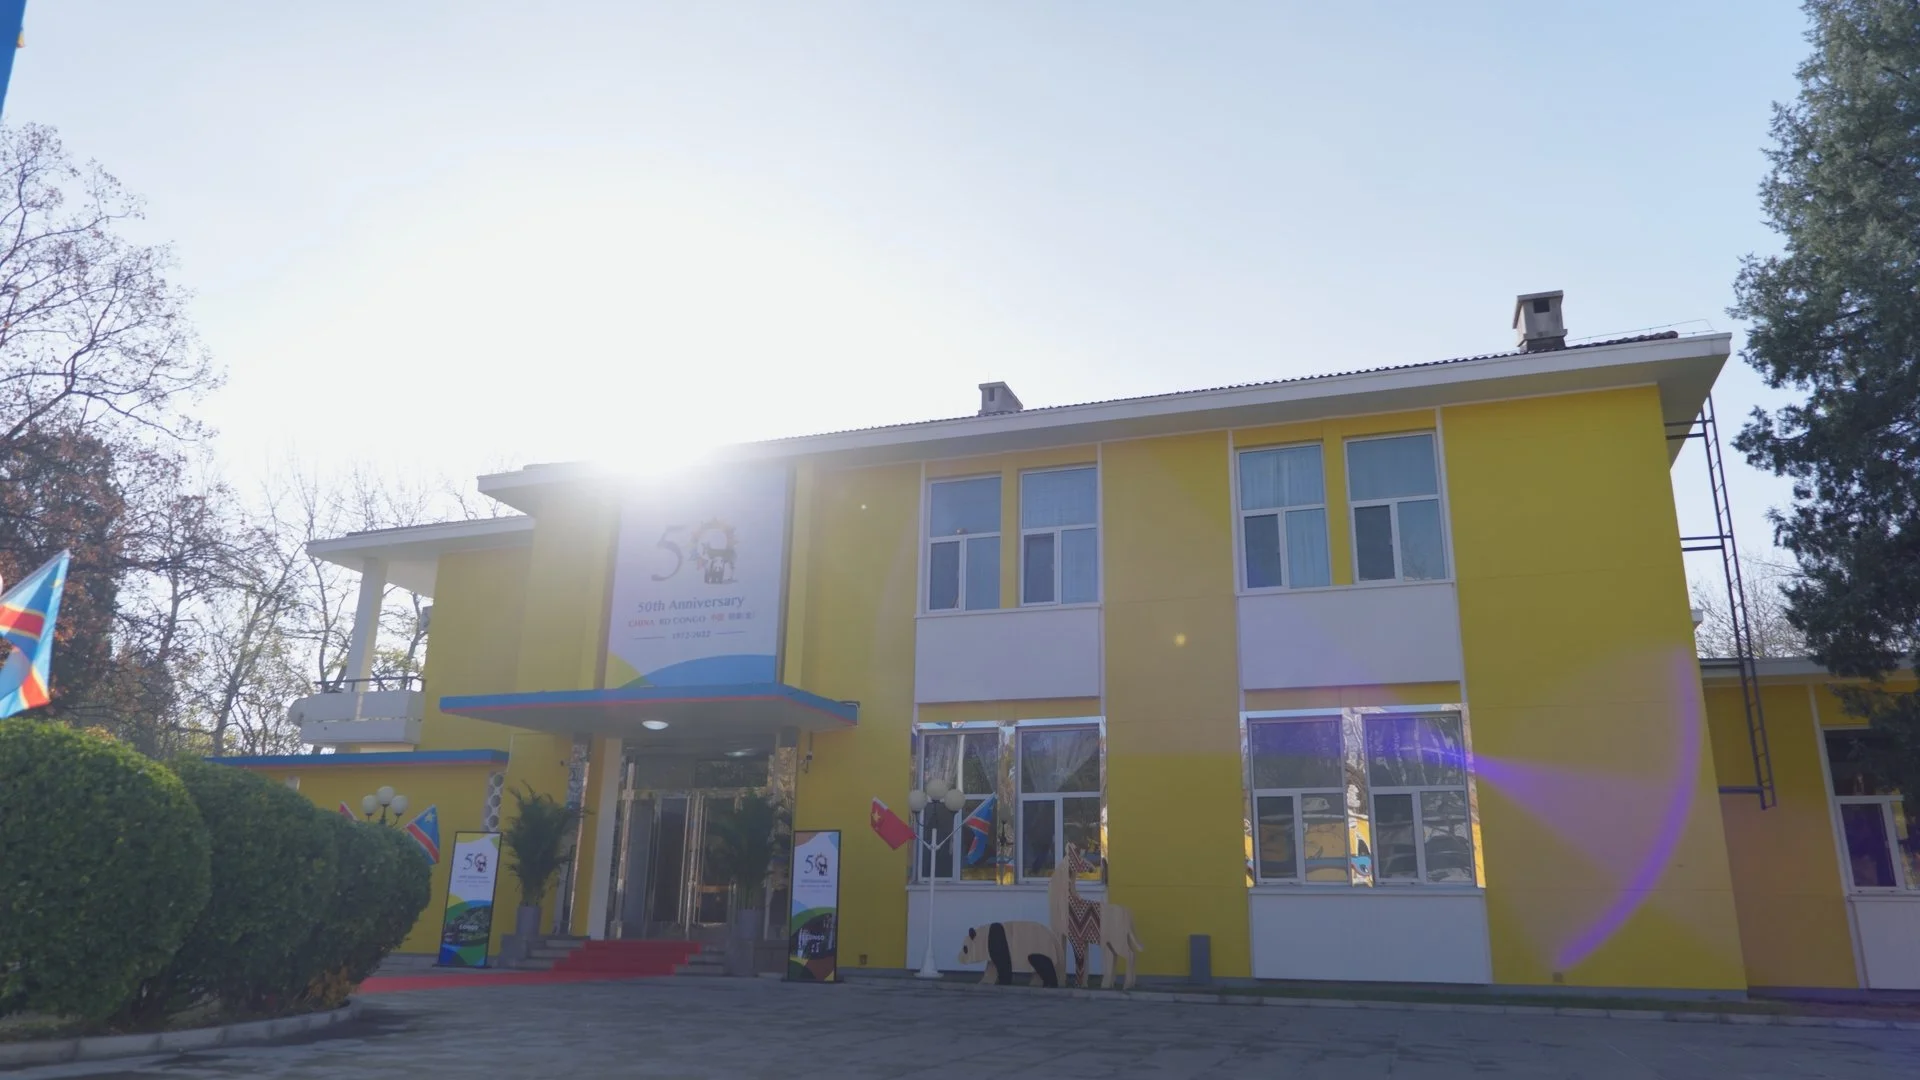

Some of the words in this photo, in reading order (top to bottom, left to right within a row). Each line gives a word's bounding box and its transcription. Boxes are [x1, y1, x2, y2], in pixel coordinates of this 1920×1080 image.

[637, 600, 666, 613] 50th
[669, 596, 745, 611] Anniversary
[628, 618, 655, 628] CHINA
[673, 615, 706, 625] CONGO
